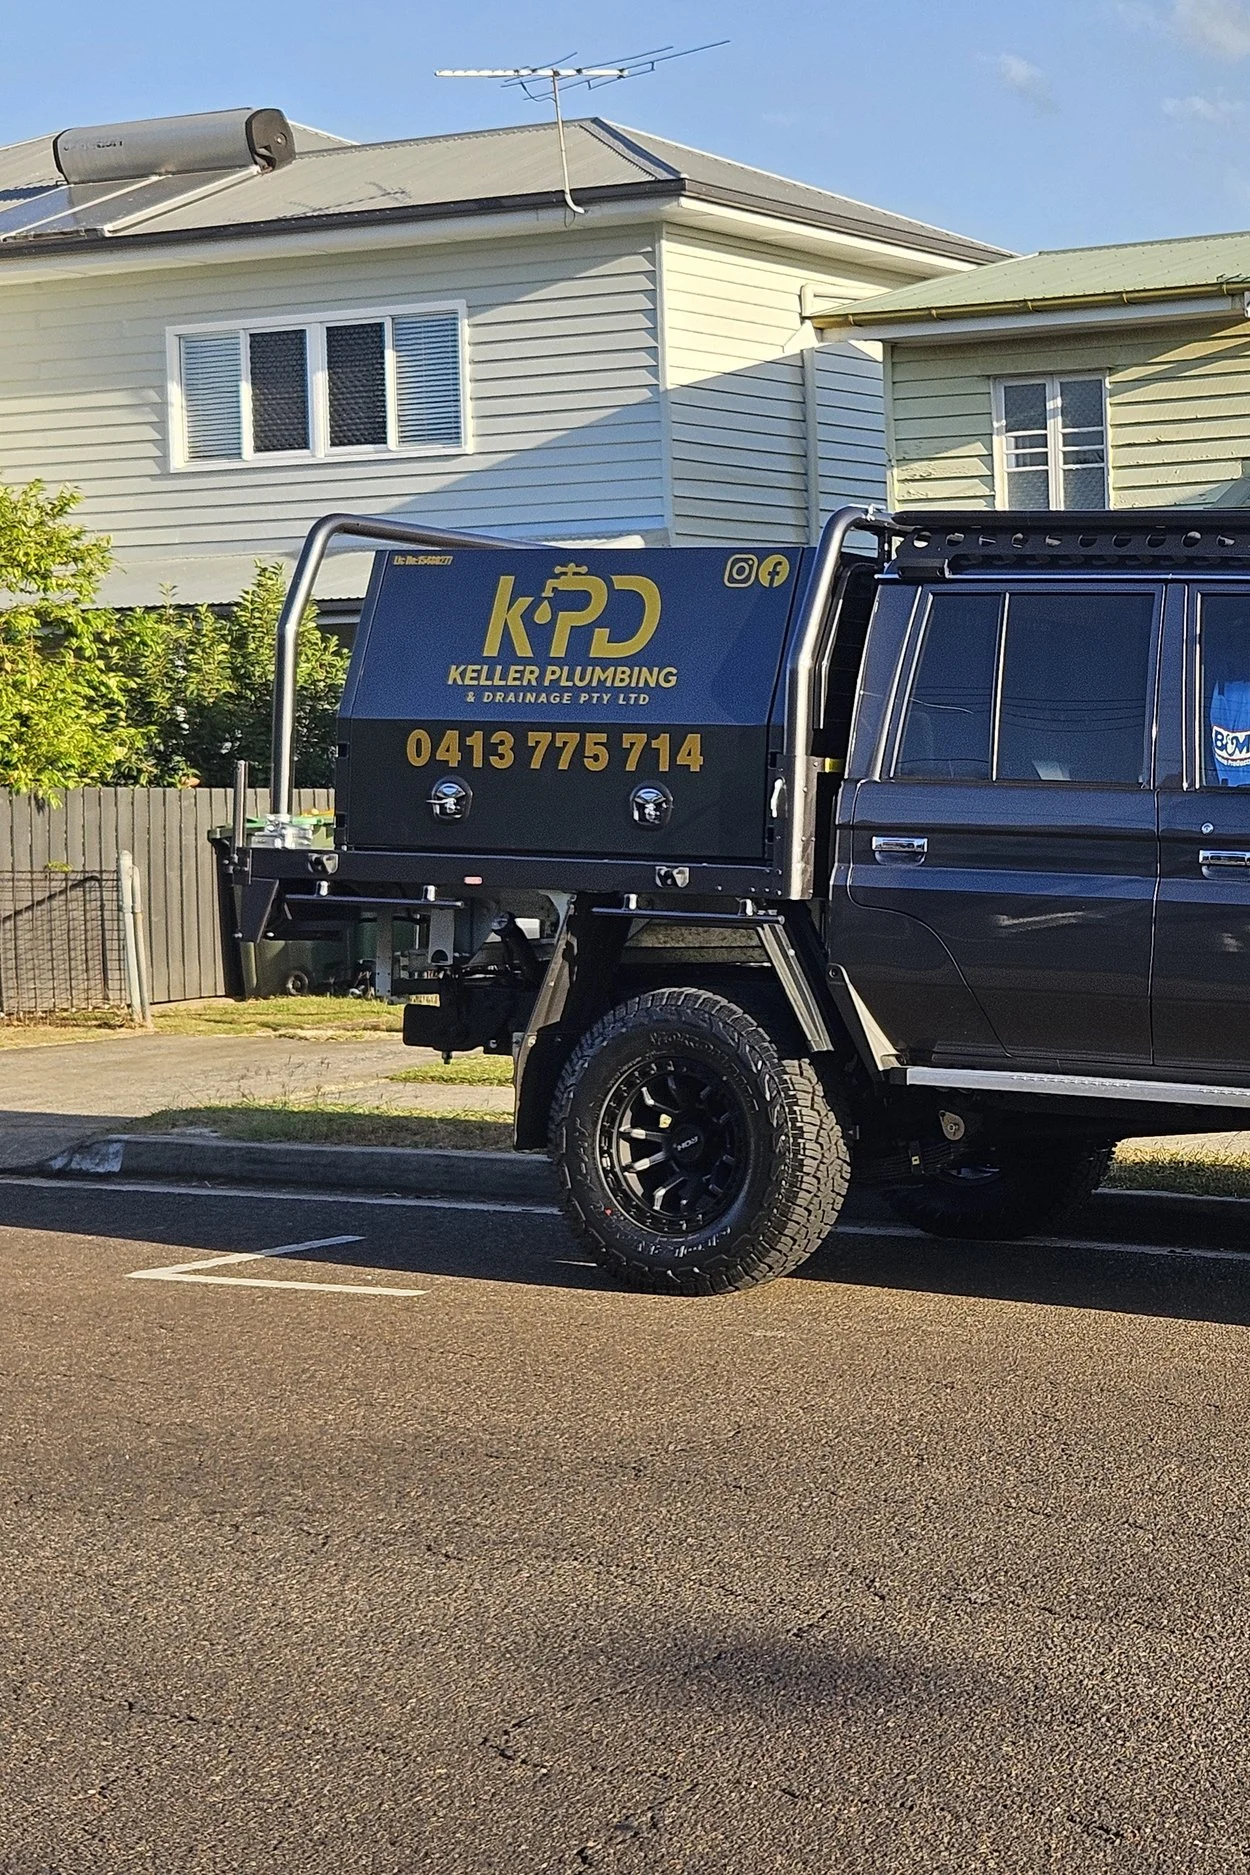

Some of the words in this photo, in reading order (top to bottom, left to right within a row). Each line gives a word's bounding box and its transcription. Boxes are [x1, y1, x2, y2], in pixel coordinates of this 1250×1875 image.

[447, 664, 540, 687] KELLER
[543, 666, 678, 688] PLUMBING
[466, 692, 476, 703] &
[483, 692, 572, 704] DRAINAGE
[580, 693, 611, 704] PTY
[618, 694, 650, 705] LTD
[406, 728, 515, 770] 0413
[527, 731, 609, 771] 775
[622, 732, 703, 772] 714
